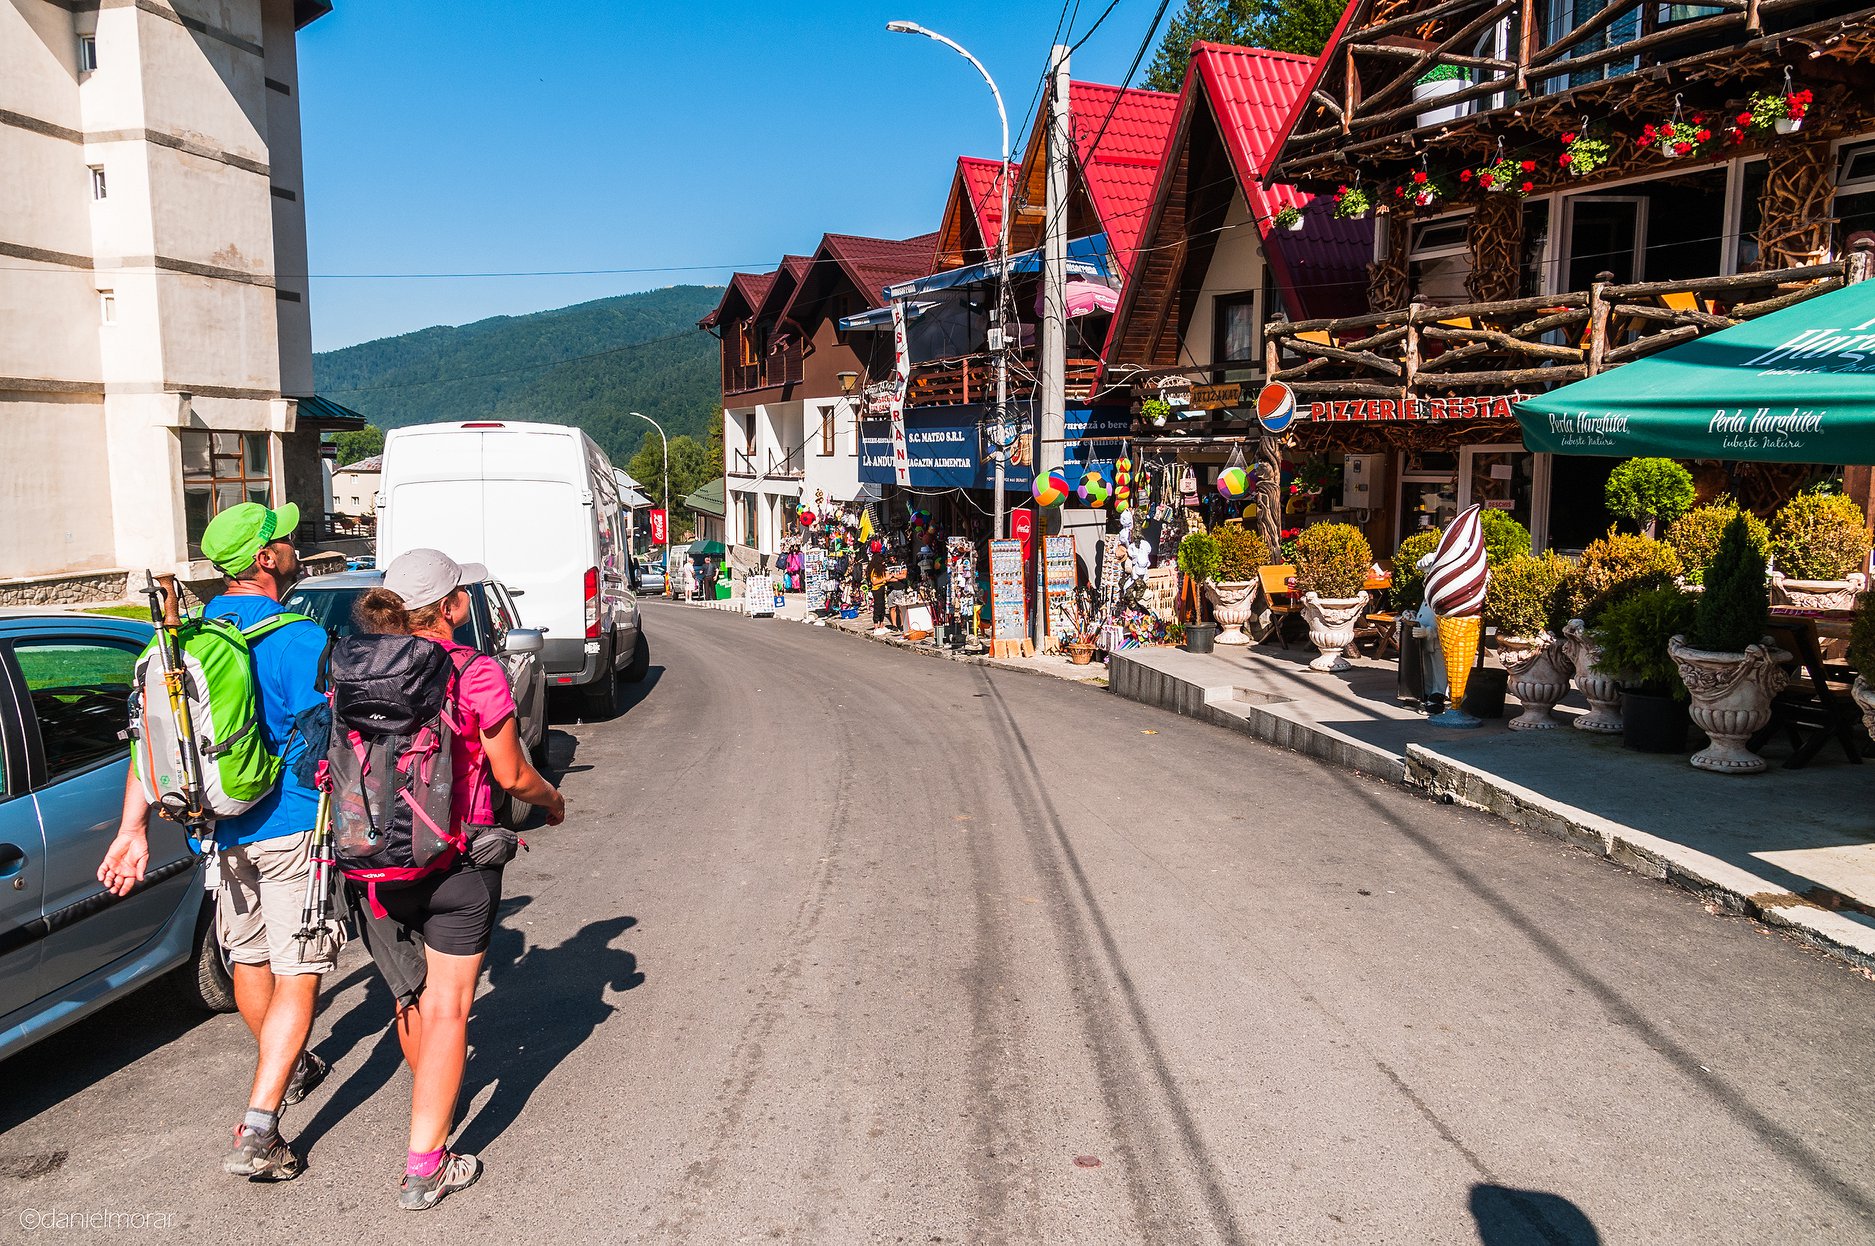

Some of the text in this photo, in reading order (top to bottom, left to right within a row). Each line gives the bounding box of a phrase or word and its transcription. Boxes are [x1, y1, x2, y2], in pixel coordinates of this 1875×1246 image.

[1739, 328, 1875, 366] Harg
[892, 299, 907, 480] ESTAURANT
[1311, 399, 1419, 422] PIZZERIE
[1108, 421, 1128, 429] bere
[1548, 412, 1631, 439] Perla Harghitei
[1708, 408, 1826, 440] Perla Harghitei
[909, 431, 965, 443] S.C. MATEO S.R.L.
[862, 456, 873, 467] LA
[934, 458, 971, 468] ALIMENTAR
